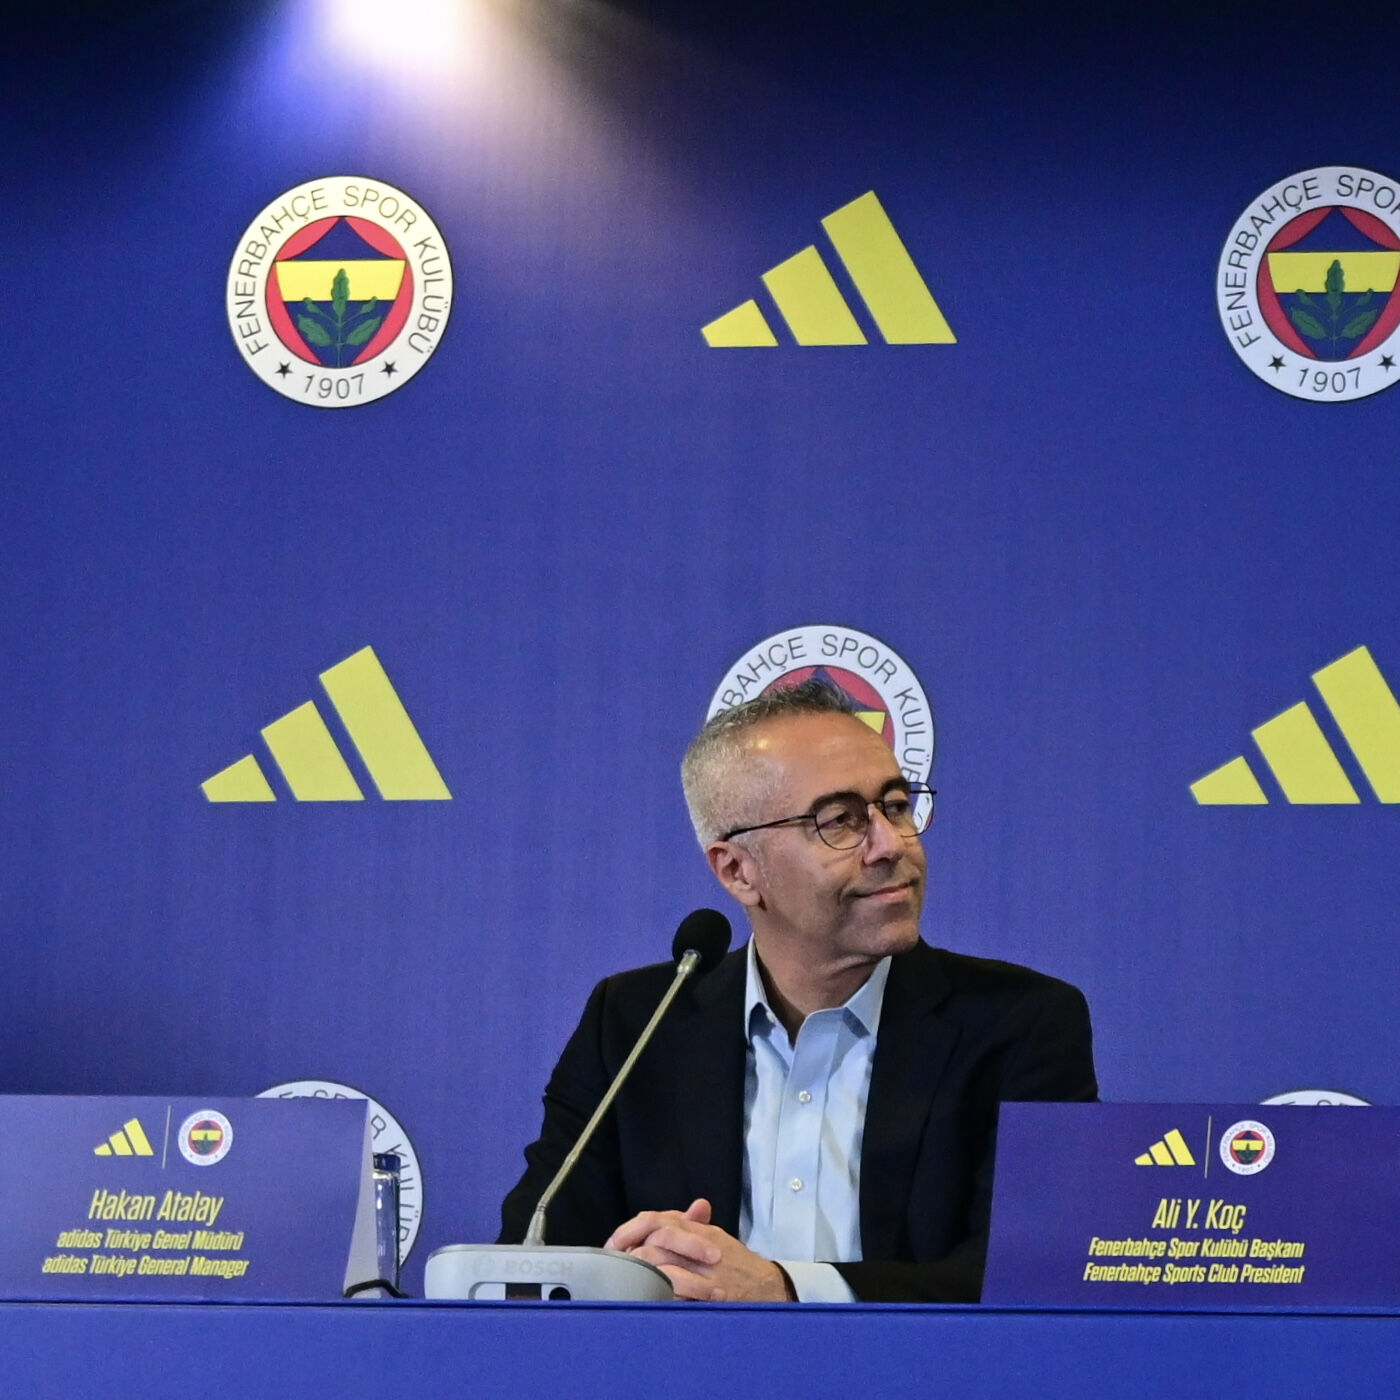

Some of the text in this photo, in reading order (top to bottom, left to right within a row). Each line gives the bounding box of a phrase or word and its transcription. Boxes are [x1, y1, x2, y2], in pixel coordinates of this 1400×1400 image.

[235, 185, 448, 355] FENERBAHÇE SPOR KULÜBÜ
[1225, 177, 1321, 348] FENERBAHÇE
[304, 374, 365, 399] 1907
[1298, 367, 1361, 393] 1907
[716, 636, 807, 712] BAHÇE
[821, 634, 898, 684] SPOR
[88, 1190, 224, 1226] Hakan Atalay
[1152, 1199, 1247, 1234] Ali Y. Koç
[57, 1229, 244, 1251] adidas Türkiye Genel Müdürü
[1088, 1238, 1304, 1260] Fenerbahçe Spor Kulübü Başkanı
[42, 1255, 249, 1278] adidas Türkiye General Manager
[504, 1259, 573, 1277] BOSCH
[1083, 1262, 1305, 1285] Fenerbahçe Sports Club President
